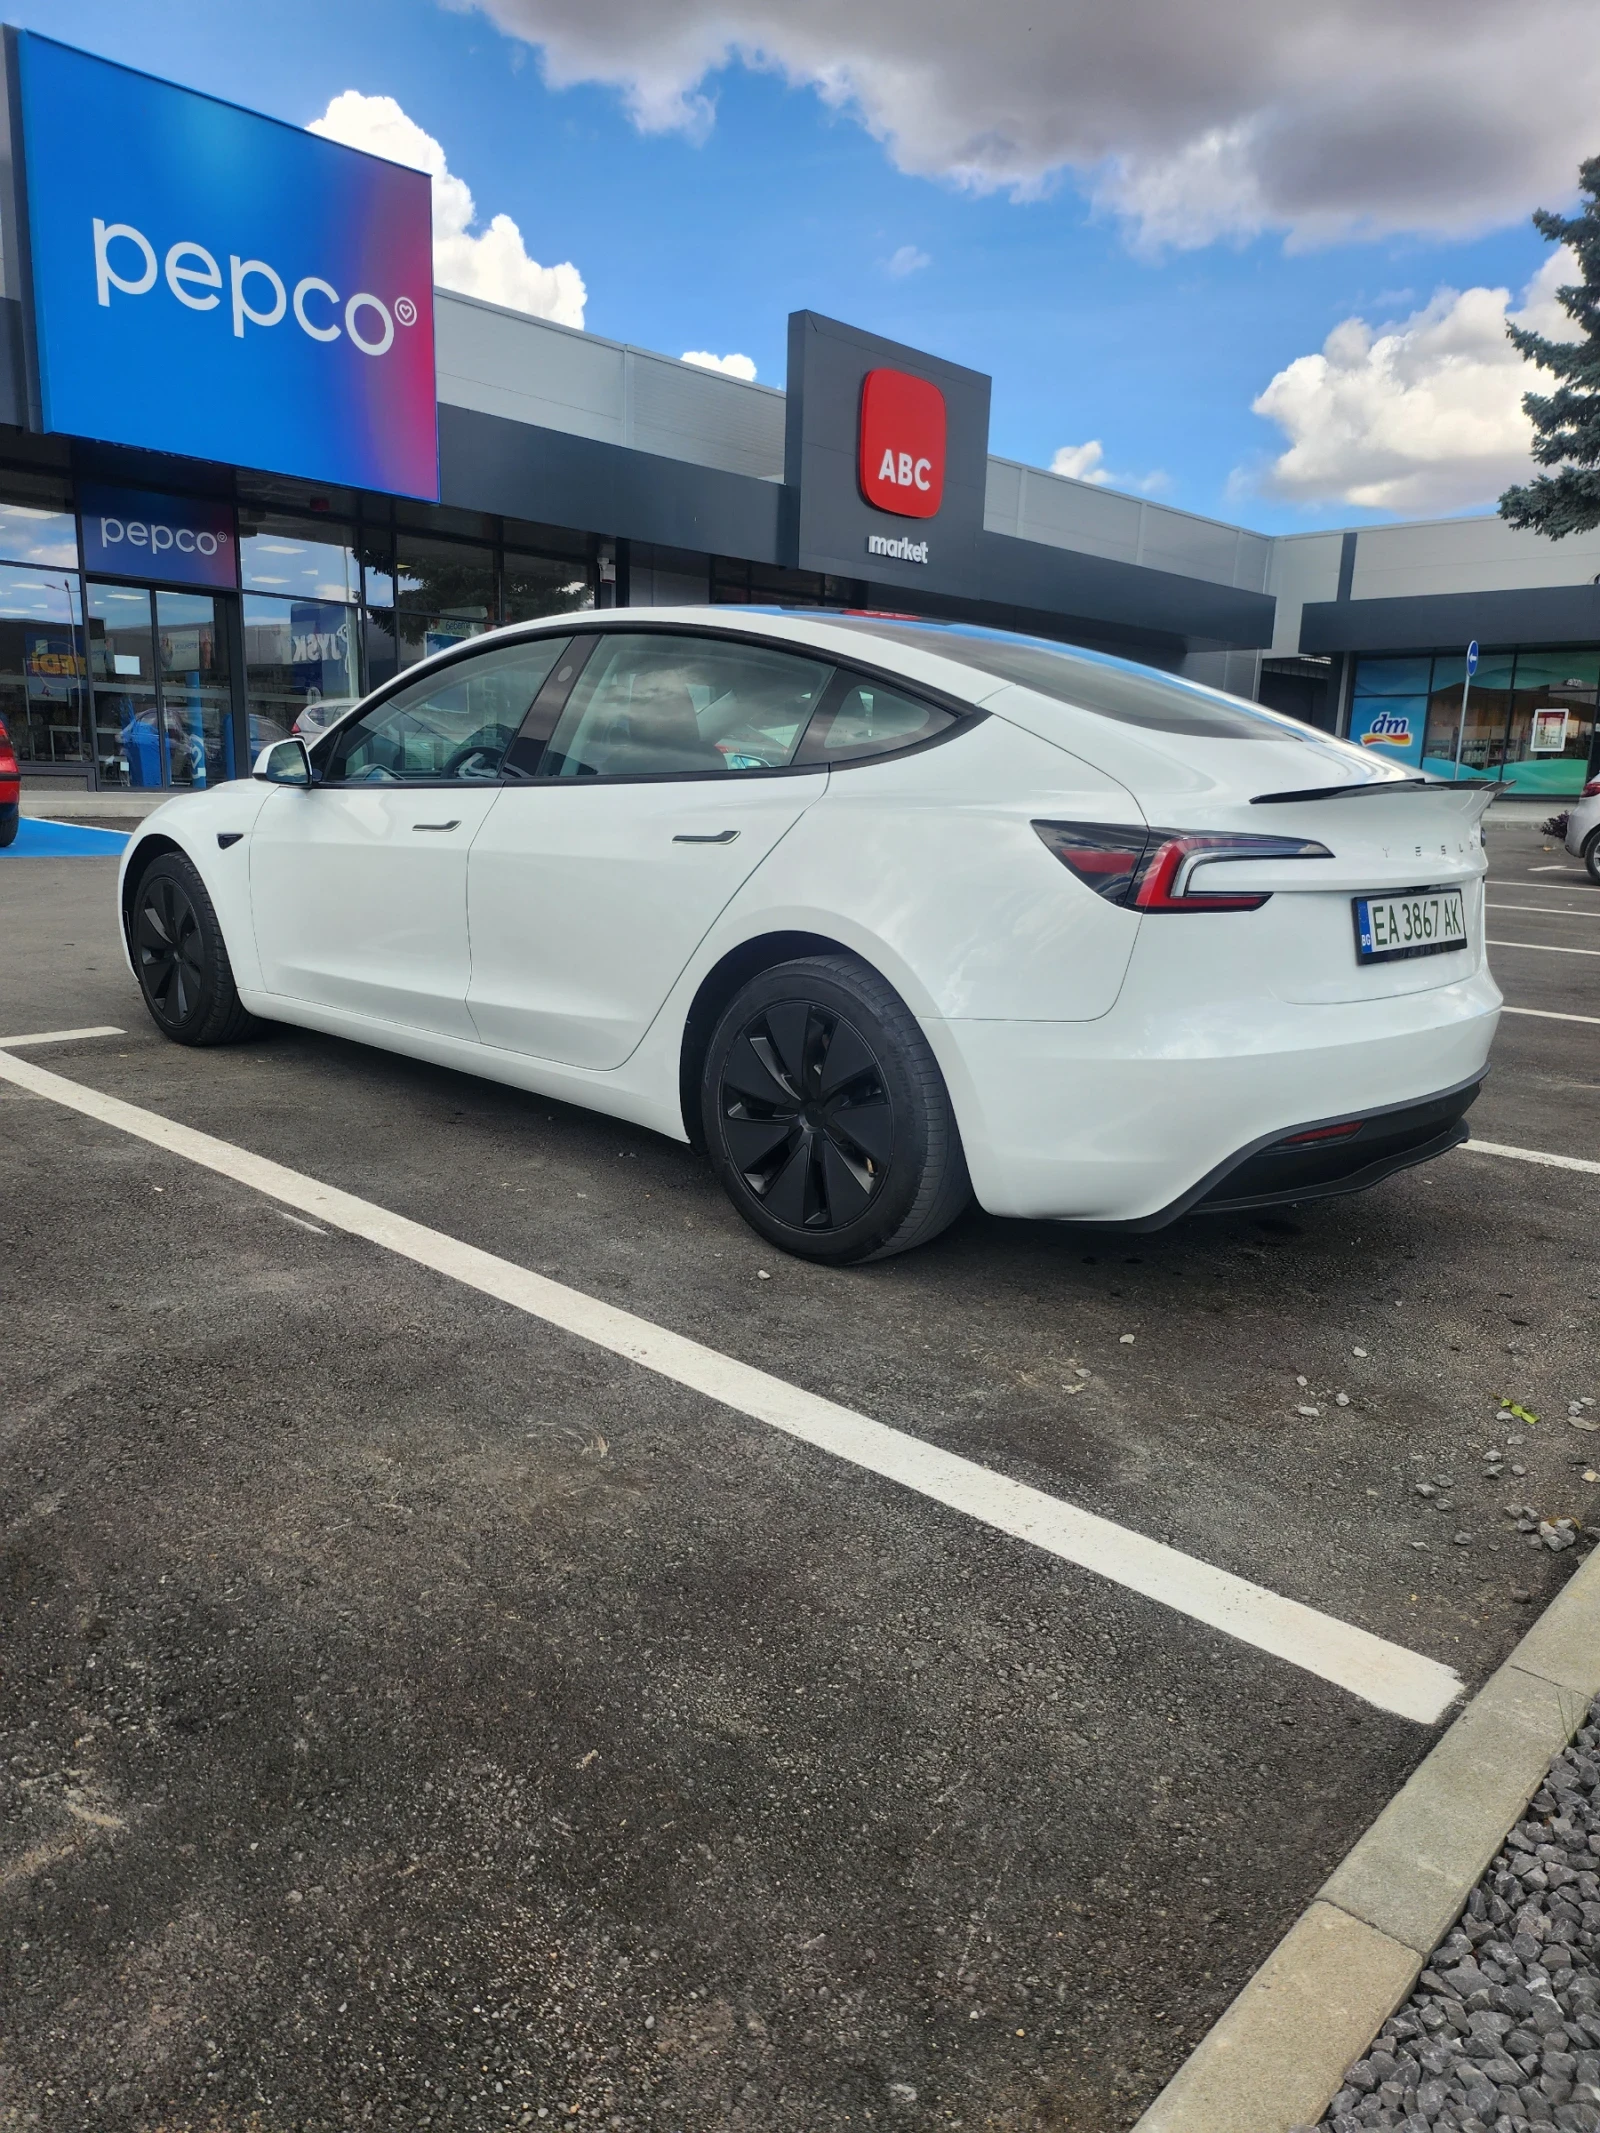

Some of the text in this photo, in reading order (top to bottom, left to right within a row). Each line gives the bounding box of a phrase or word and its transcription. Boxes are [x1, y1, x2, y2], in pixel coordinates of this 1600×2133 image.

[93, 218, 394, 356] pepco
[878, 448, 932, 491] ABC
[100, 517, 218, 555] pepco
[868, 535, 929, 564] market
[1371, 713, 1408, 734] dm
[1361, 933, 1371, 947] BG
[1372, 898, 1462, 946] EA 3867 AK
